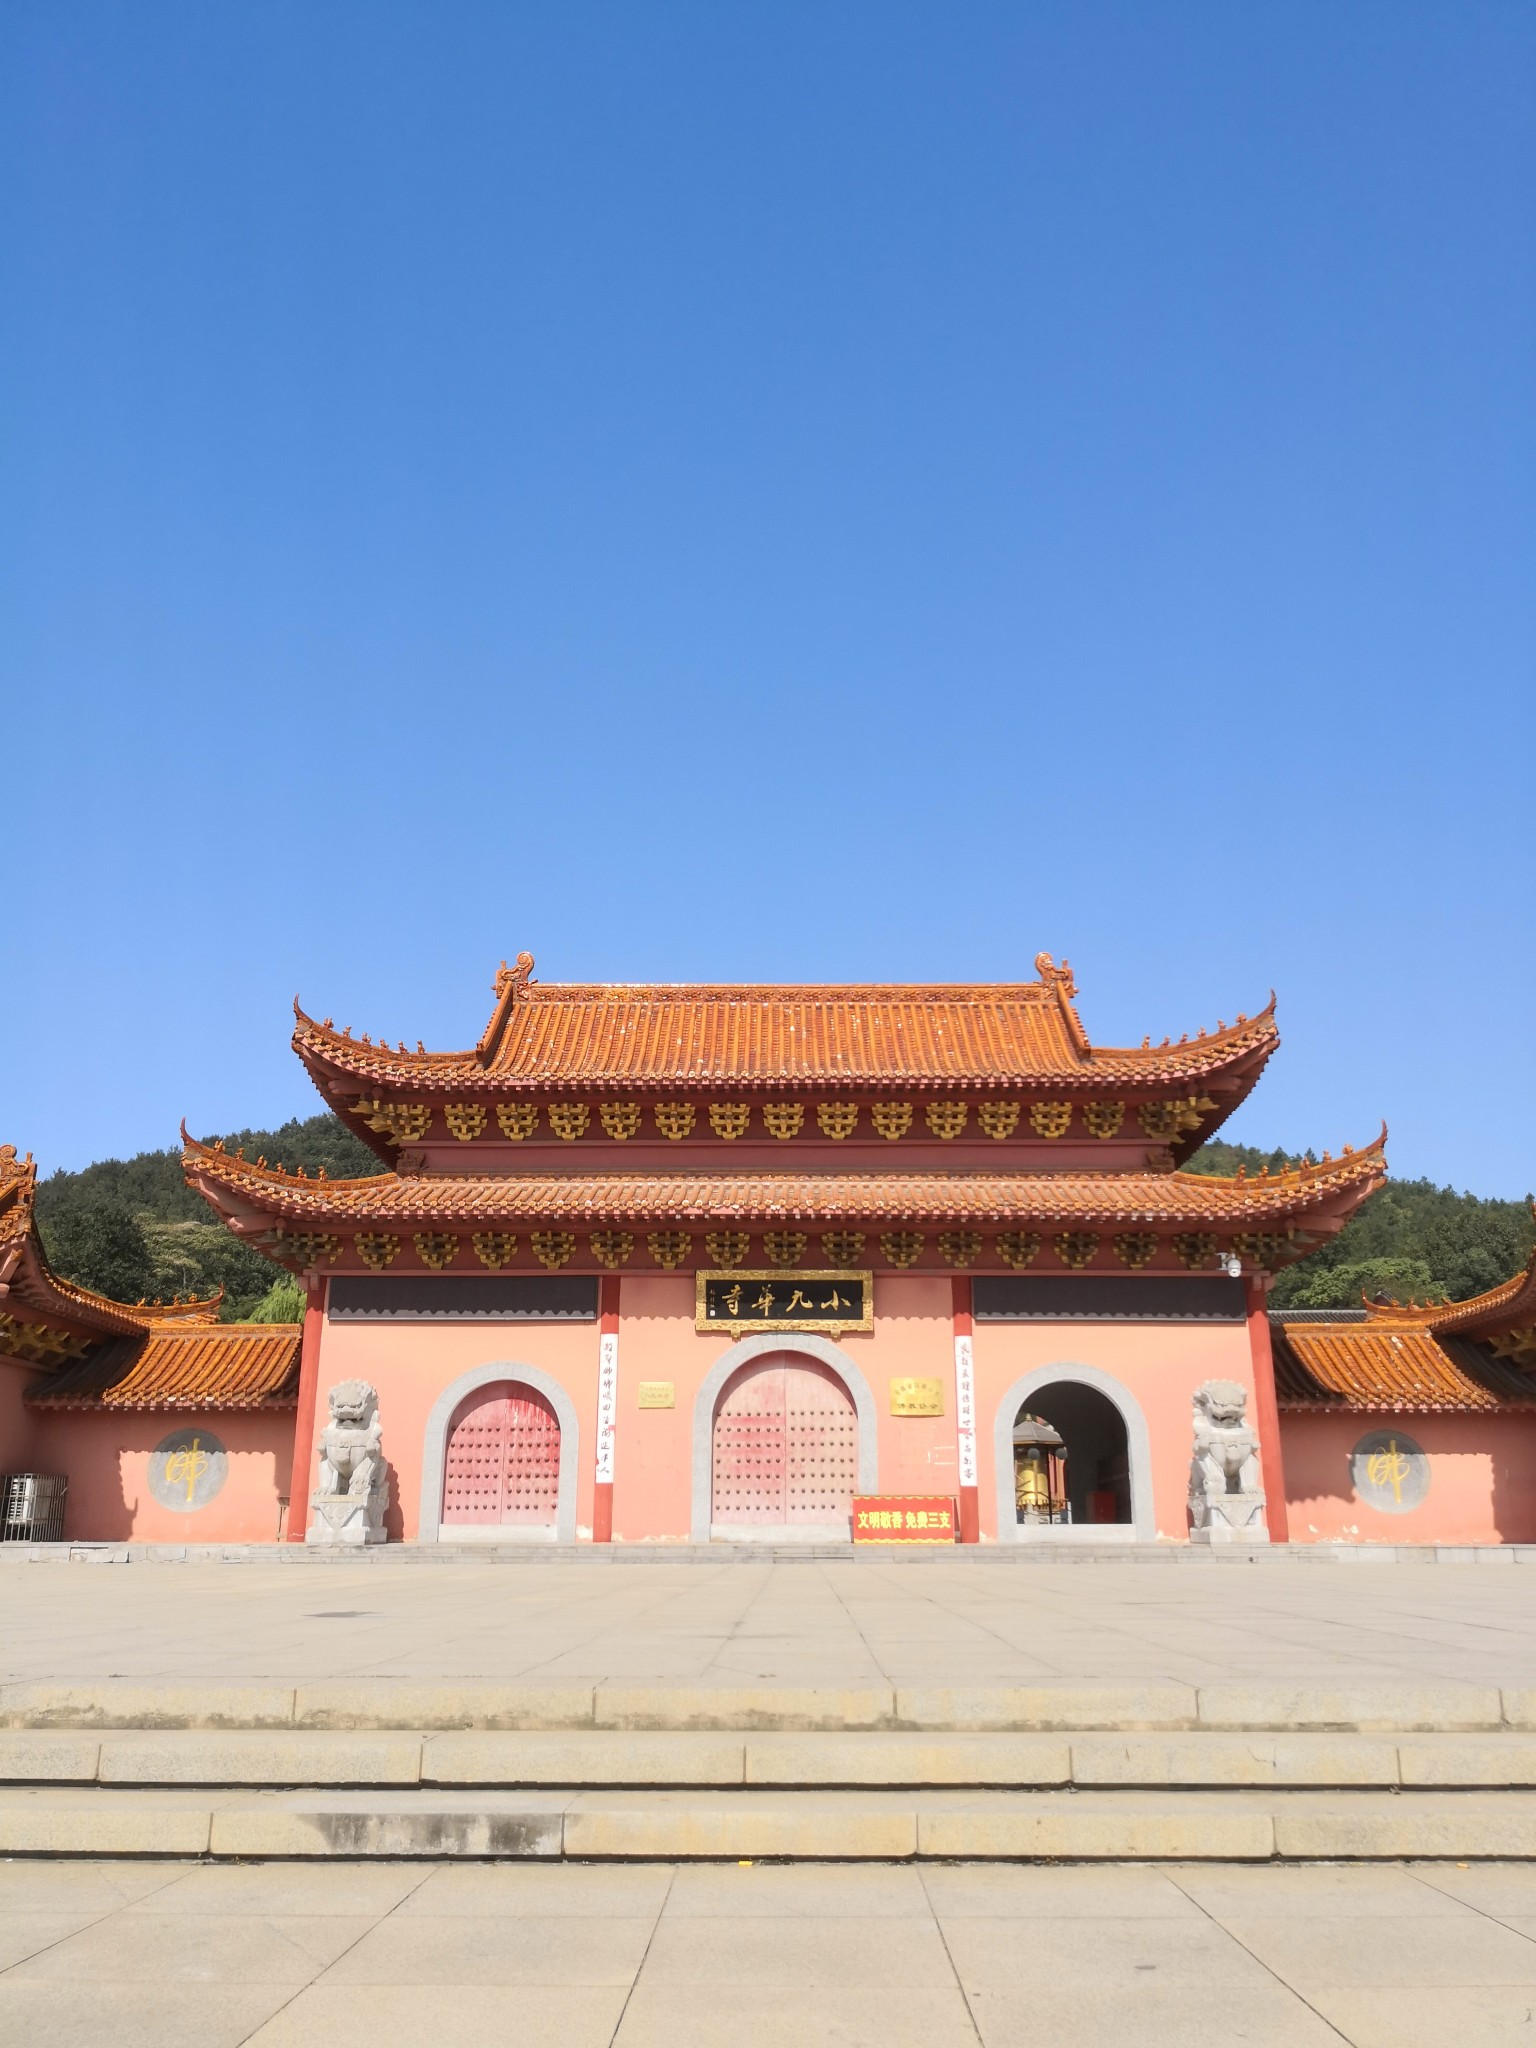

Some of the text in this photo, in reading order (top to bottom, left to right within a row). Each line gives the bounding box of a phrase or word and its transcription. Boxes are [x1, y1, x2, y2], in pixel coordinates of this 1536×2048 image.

[858, 1511, 950, 1528] 文明敬香 免费三支
